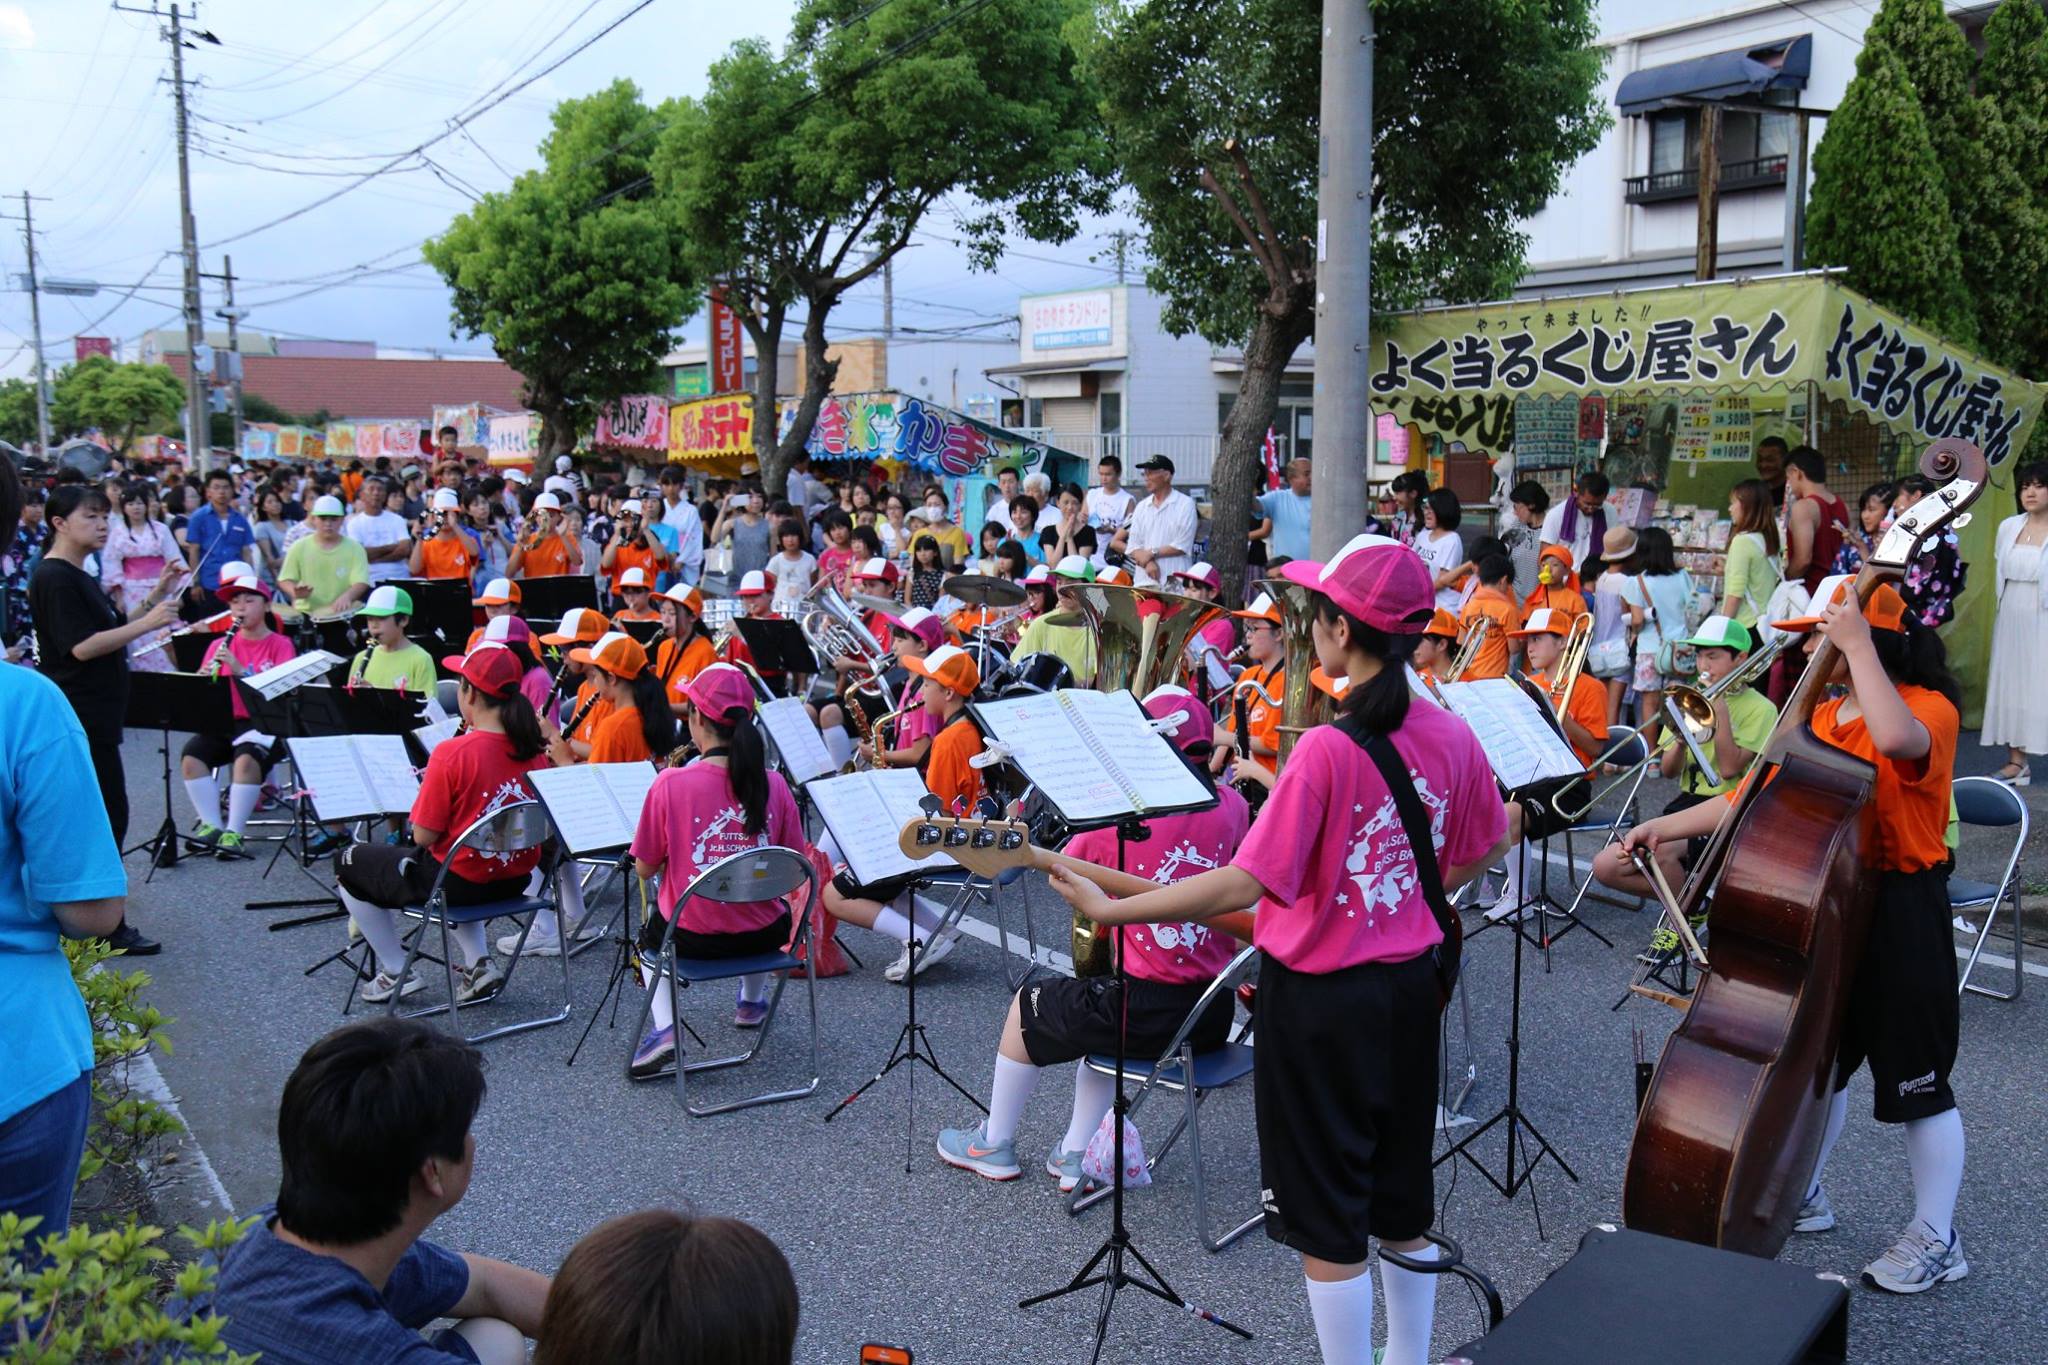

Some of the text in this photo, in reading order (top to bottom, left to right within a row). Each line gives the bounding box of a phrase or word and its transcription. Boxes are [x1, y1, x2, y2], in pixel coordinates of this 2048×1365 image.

[1370, 311, 1798, 392] よく当るくじ屋さん
